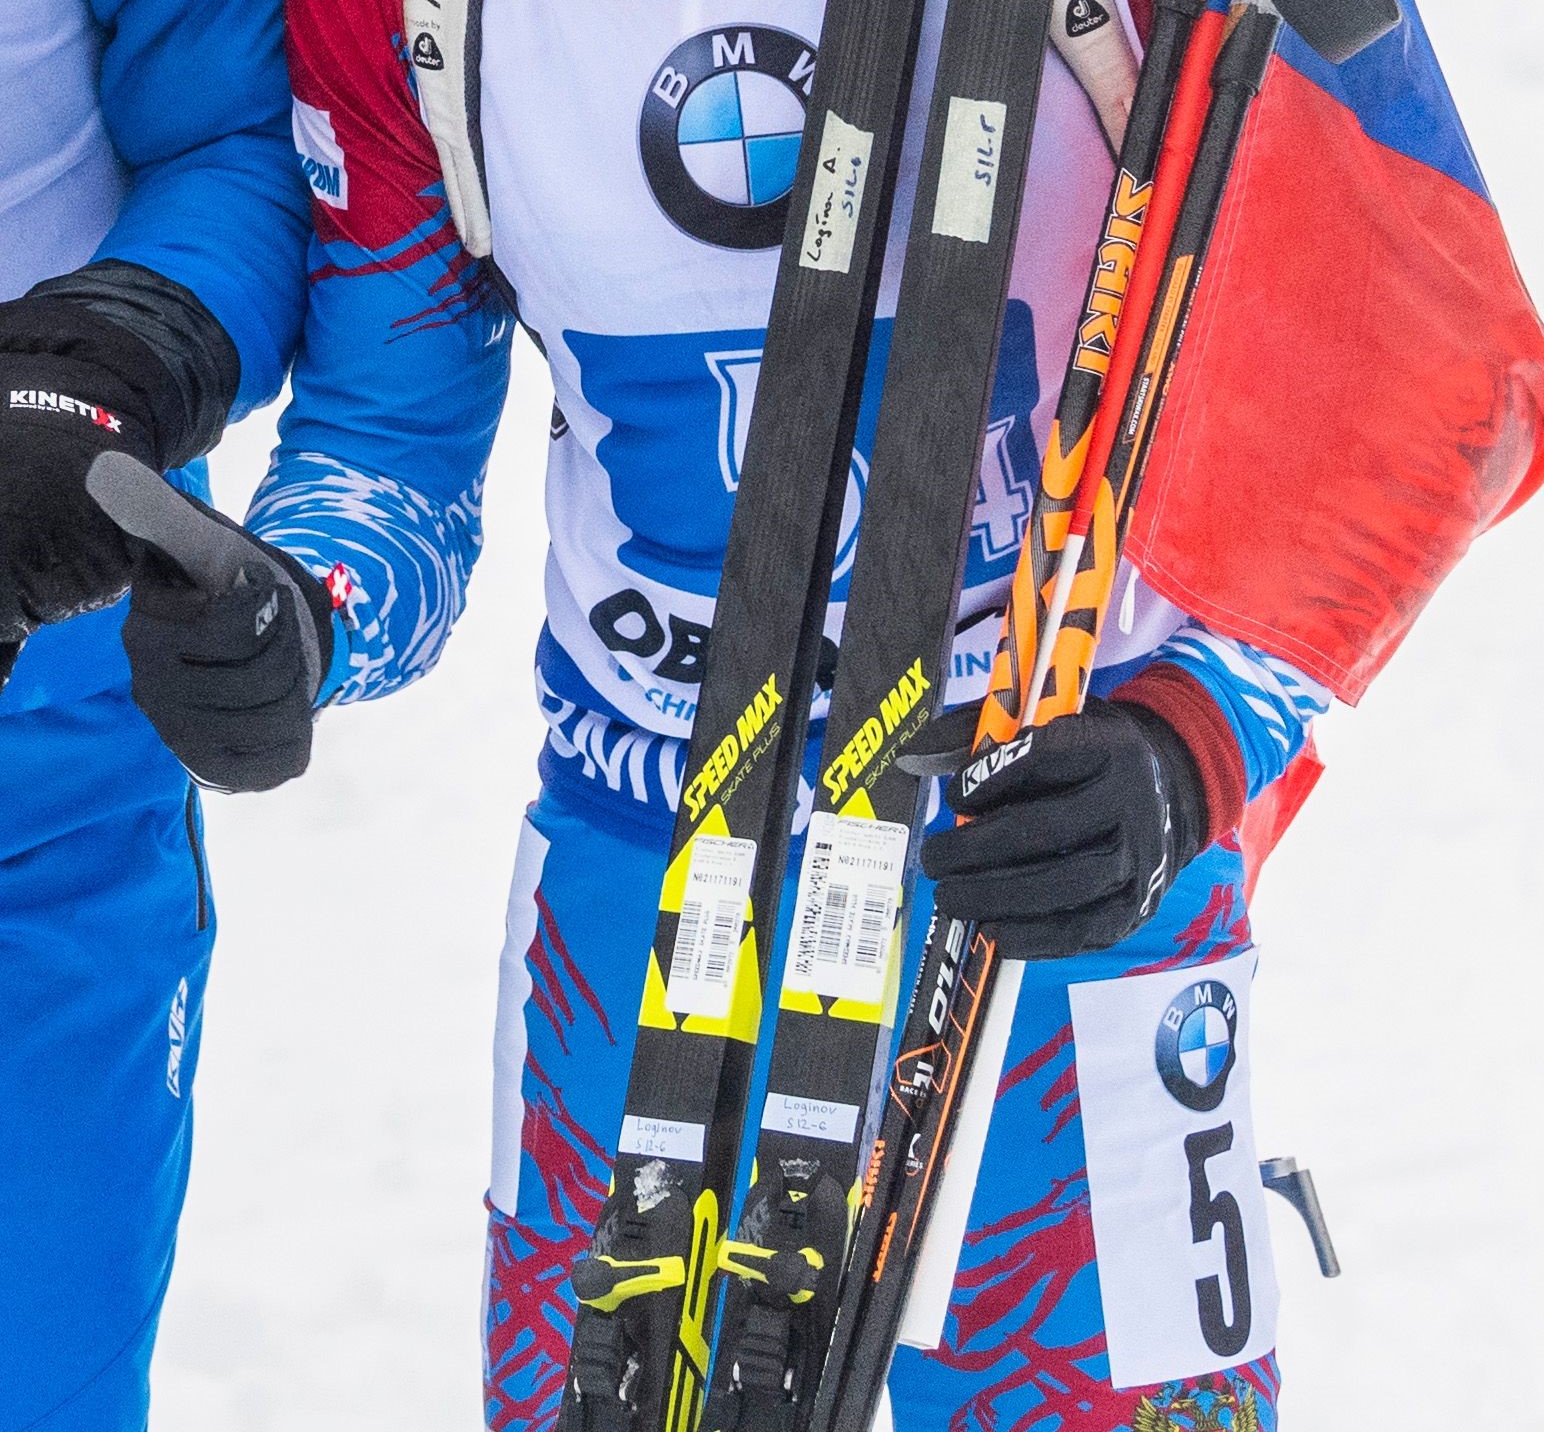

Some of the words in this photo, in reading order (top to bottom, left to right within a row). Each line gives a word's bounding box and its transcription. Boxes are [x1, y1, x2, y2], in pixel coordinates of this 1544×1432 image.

[652, 31, 820, 110] BMW
[1074, 167, 1153, 378] START
[970, 415, 1036, 562] 4
[683, 733, 740, 822] SPEED
[738, 672, 783, 758] MAX
[721, 755, 752, 805] SKATE
[752, 721, 783, 763] PLUS
[822, 717, 883, 805] SPEED
[880, 657, 931, 741] MAX
[900, 706, 930, 746] PLUS
[1164, 984, 1237, 1031] BMW
[637, 1118, 682, 1135] Loginov
[784, 1099, 838, 1117] Loginov
[1184, 1121, 1252, 1358] 5
